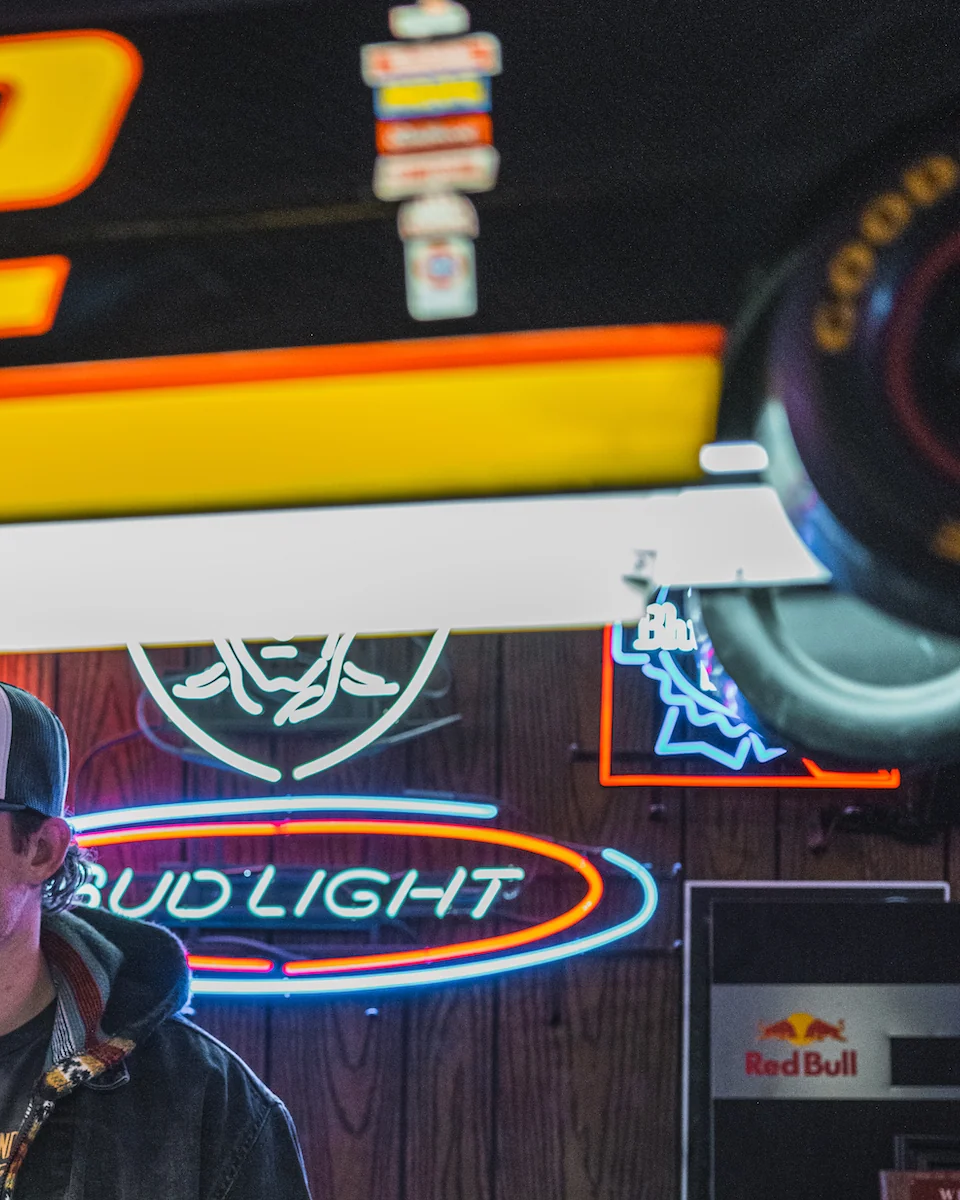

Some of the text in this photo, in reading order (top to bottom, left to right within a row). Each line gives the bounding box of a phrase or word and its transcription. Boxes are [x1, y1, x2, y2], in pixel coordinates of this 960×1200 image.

[246, 864, 526, 920] LIGHT
[745, 1051, 858, 1077] Red Bull
